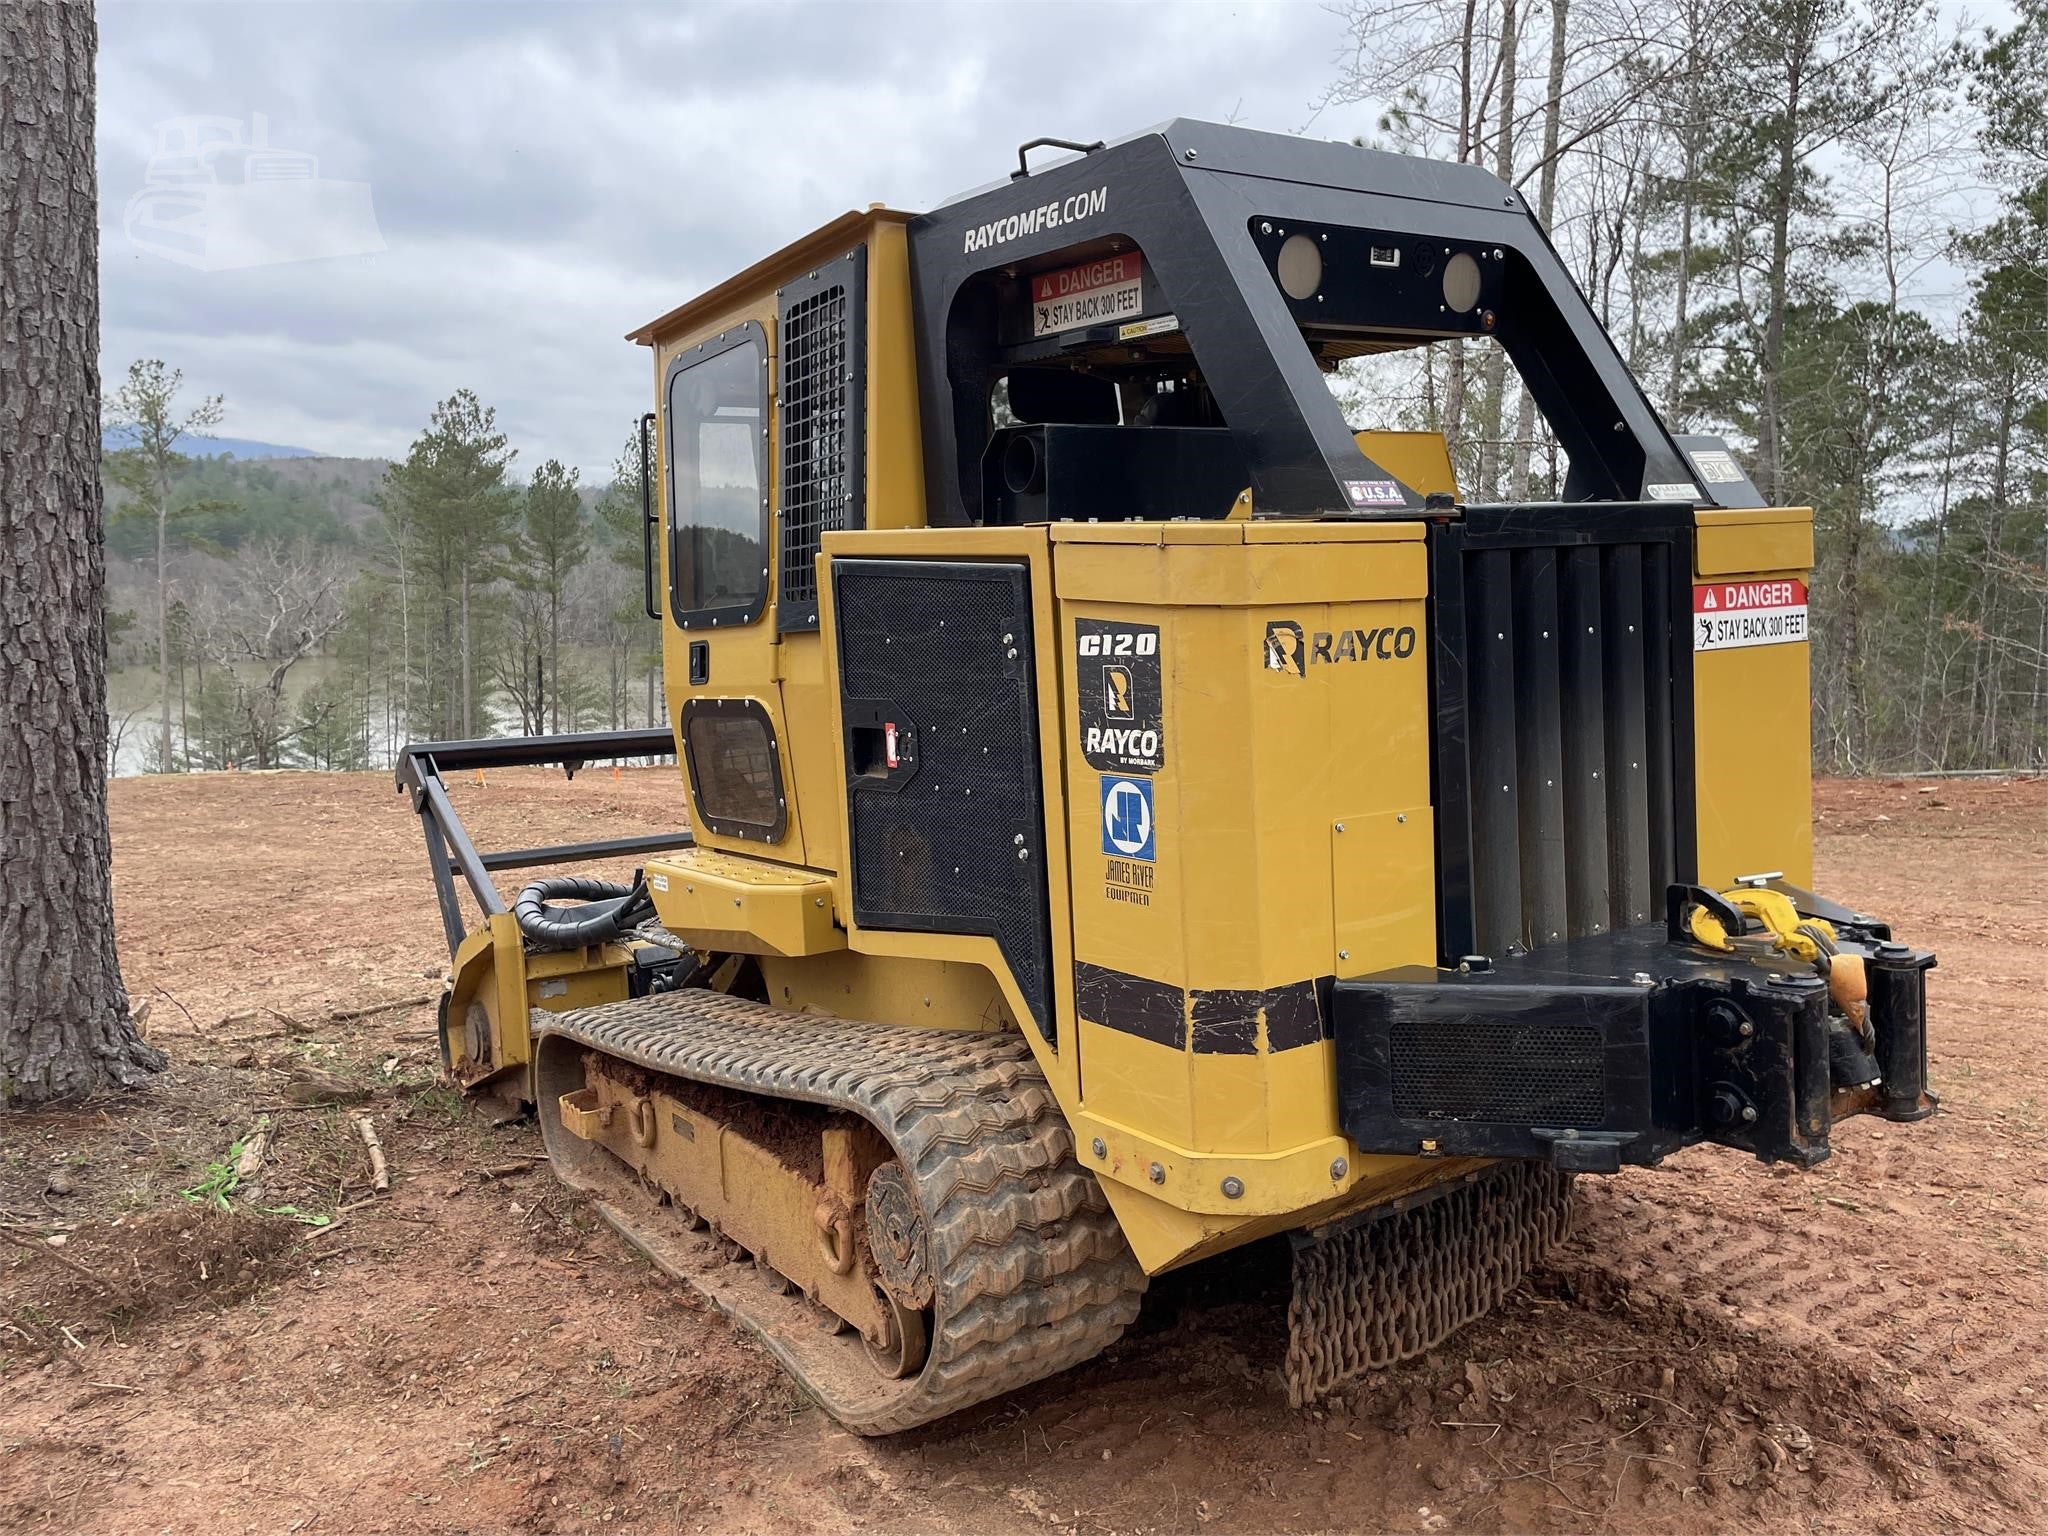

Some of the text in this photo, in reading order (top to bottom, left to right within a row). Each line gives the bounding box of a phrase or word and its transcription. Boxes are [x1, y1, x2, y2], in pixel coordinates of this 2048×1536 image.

[964, 186, 1107, 253] RAYCOMFG.COM
[1059, 259, 1124, 294] DANGER
[1053, 287, 1139, 326] STAY BACK 300 FEET
[1725, 583, 1793, 608] DANGER
[1718, 614, 1805, 641] STAY BACK 300 FEET
[1310, 626, 1416, 665] RAYCO
[1086, 727, 1158, 757] RAYCO
[1105, 859, 1131, 884] JAMES
